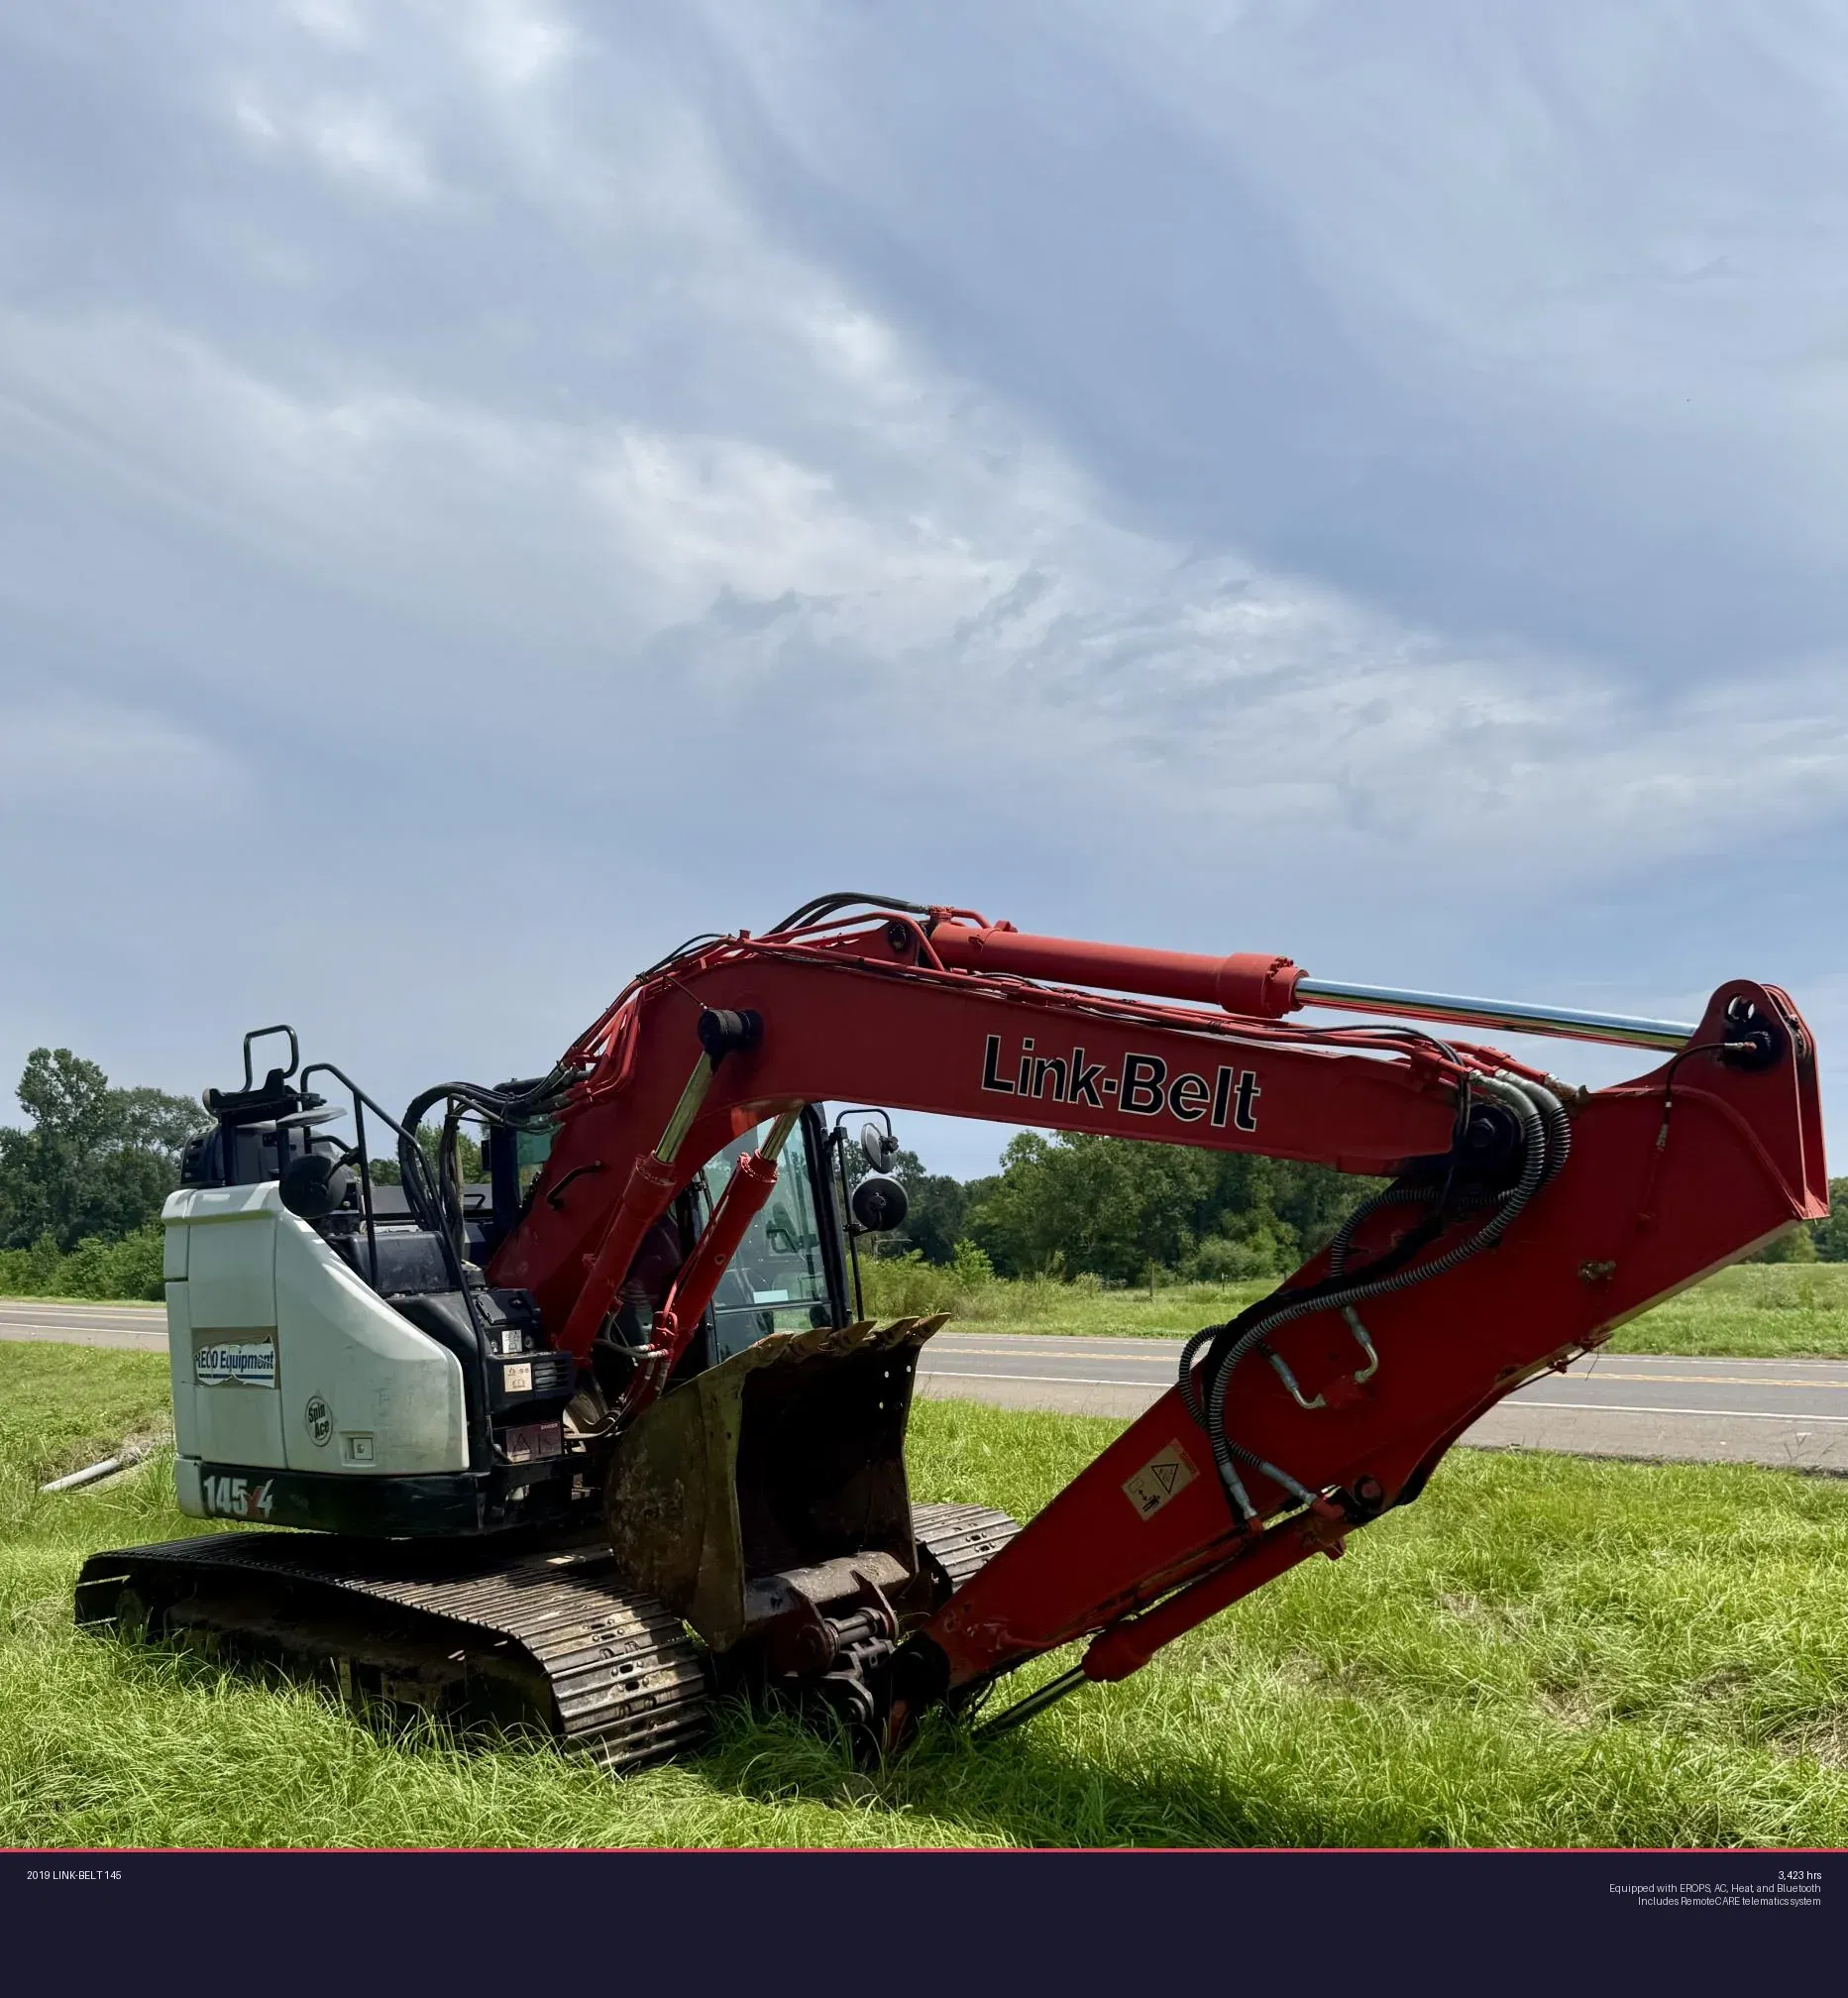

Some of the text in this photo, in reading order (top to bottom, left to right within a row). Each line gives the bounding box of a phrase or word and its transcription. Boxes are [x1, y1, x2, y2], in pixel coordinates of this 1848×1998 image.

[981, 1034, 1261, 1132] Link-Belt
[220, 1350, 274, 1374] Equipment
[308, 1402, 326, 1423] Spin
[314, 1419, 330, 1439] Ace
